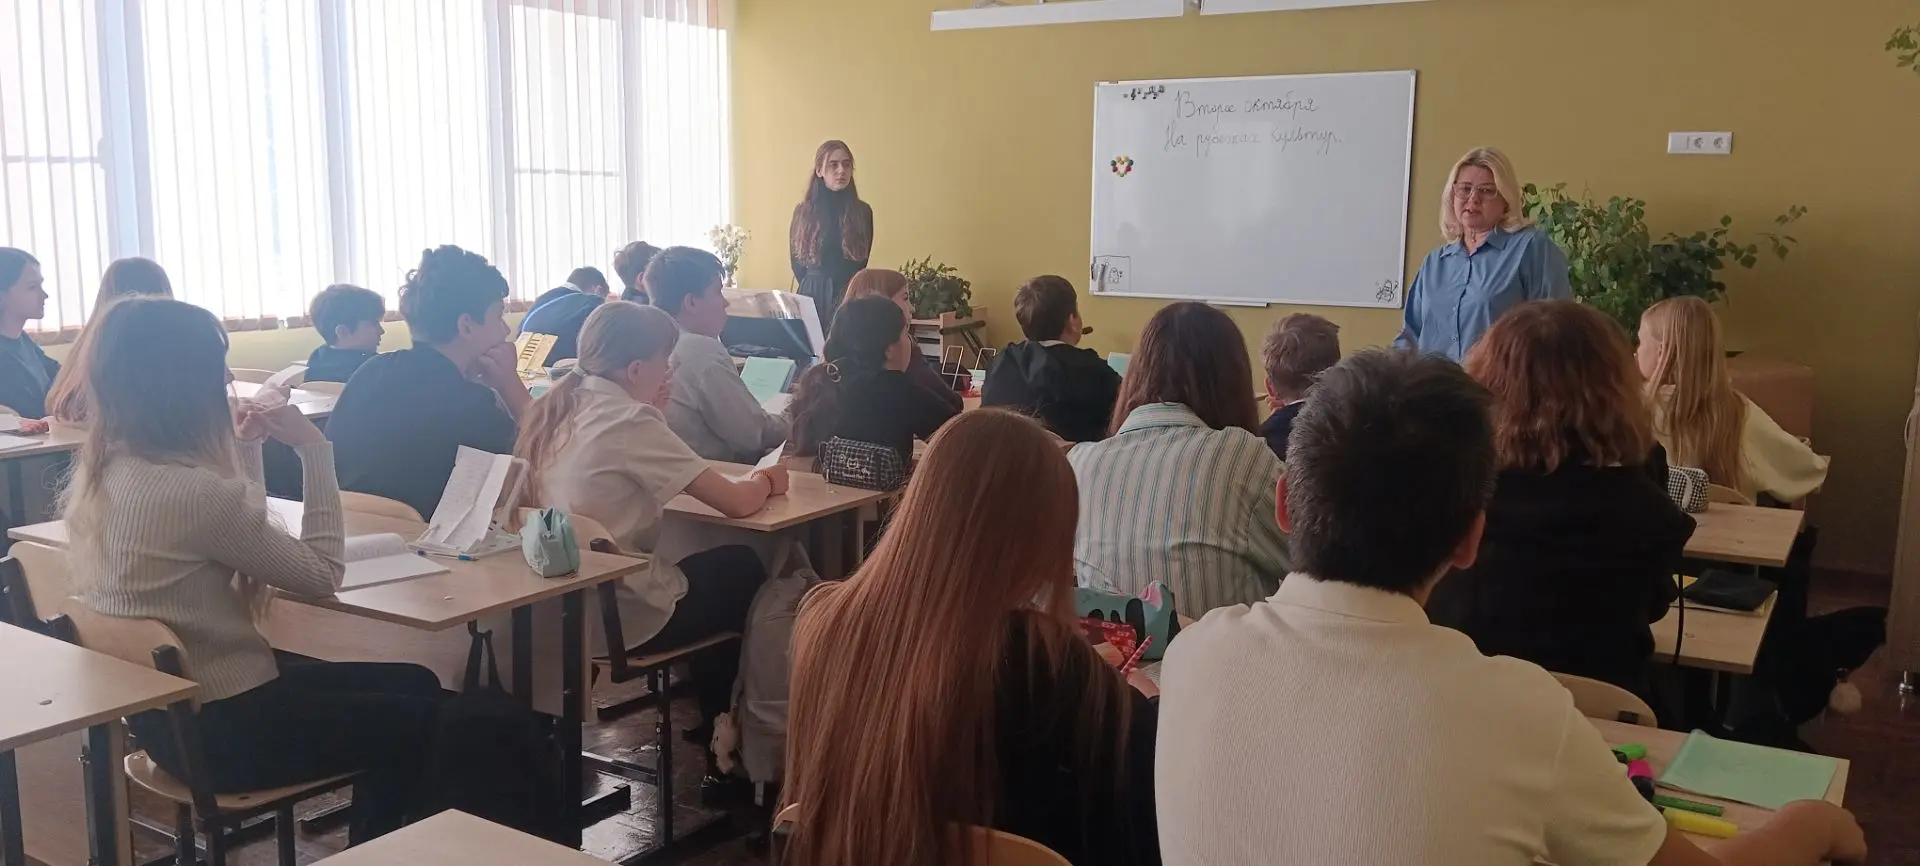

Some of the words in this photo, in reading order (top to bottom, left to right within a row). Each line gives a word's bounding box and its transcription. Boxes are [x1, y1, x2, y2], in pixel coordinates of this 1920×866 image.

[1174, 89, 1237, 123] Второе
[1244, 89, 1320, 121] октября
[1163, 119, 1188, 153] На
